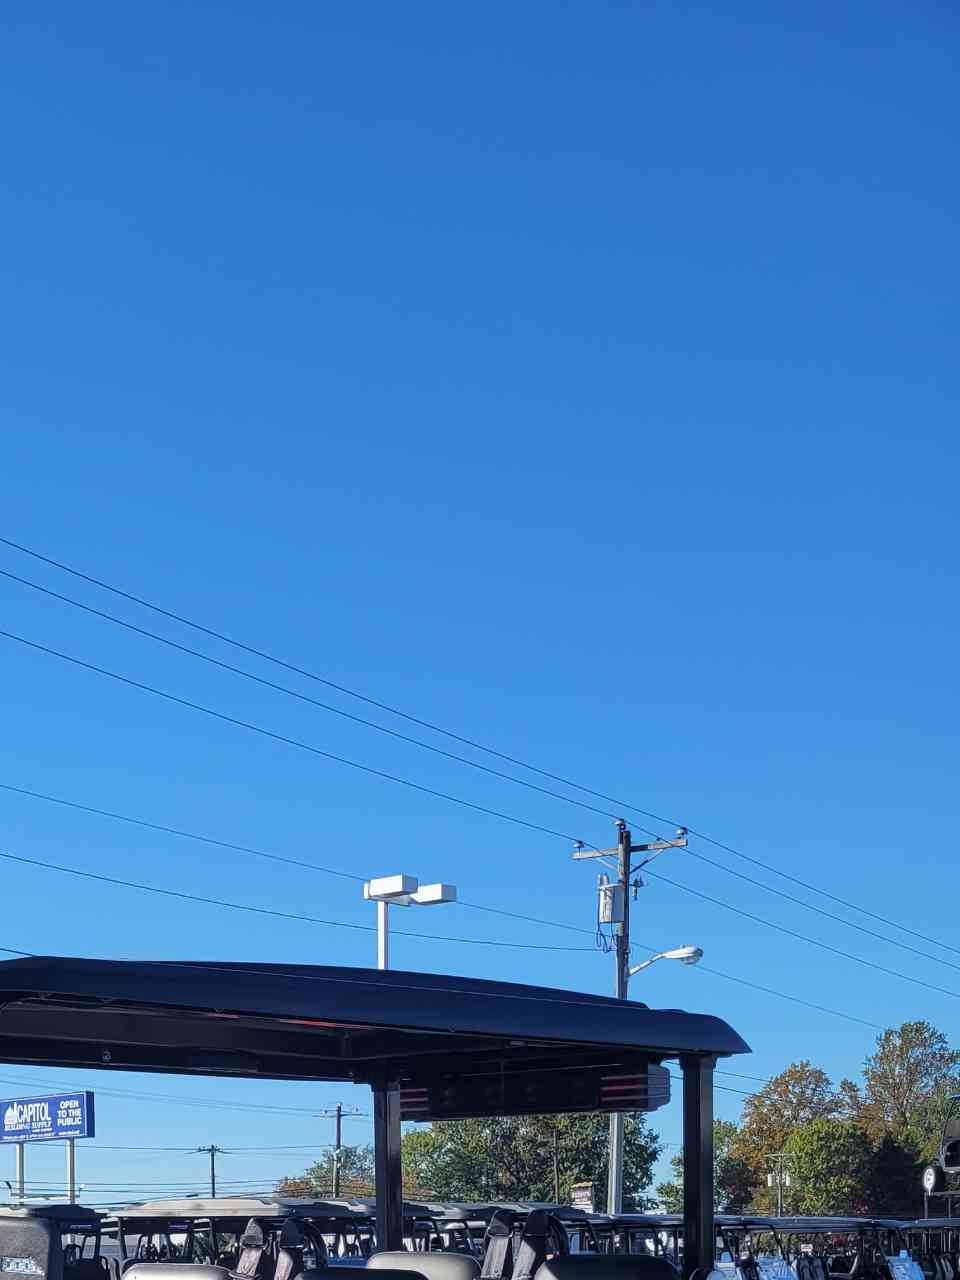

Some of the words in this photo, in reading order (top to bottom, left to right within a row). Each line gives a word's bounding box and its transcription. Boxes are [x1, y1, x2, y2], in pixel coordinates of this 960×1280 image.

[60, 1100, 80, 1109] OPEN
[17, 1102, 52, 1123] CAPITOL
[57, 1110, 68, 1118] TO
[68, 1108, 82, 1117] THE
[57, 1116, 82, 1127] PUBLIC
